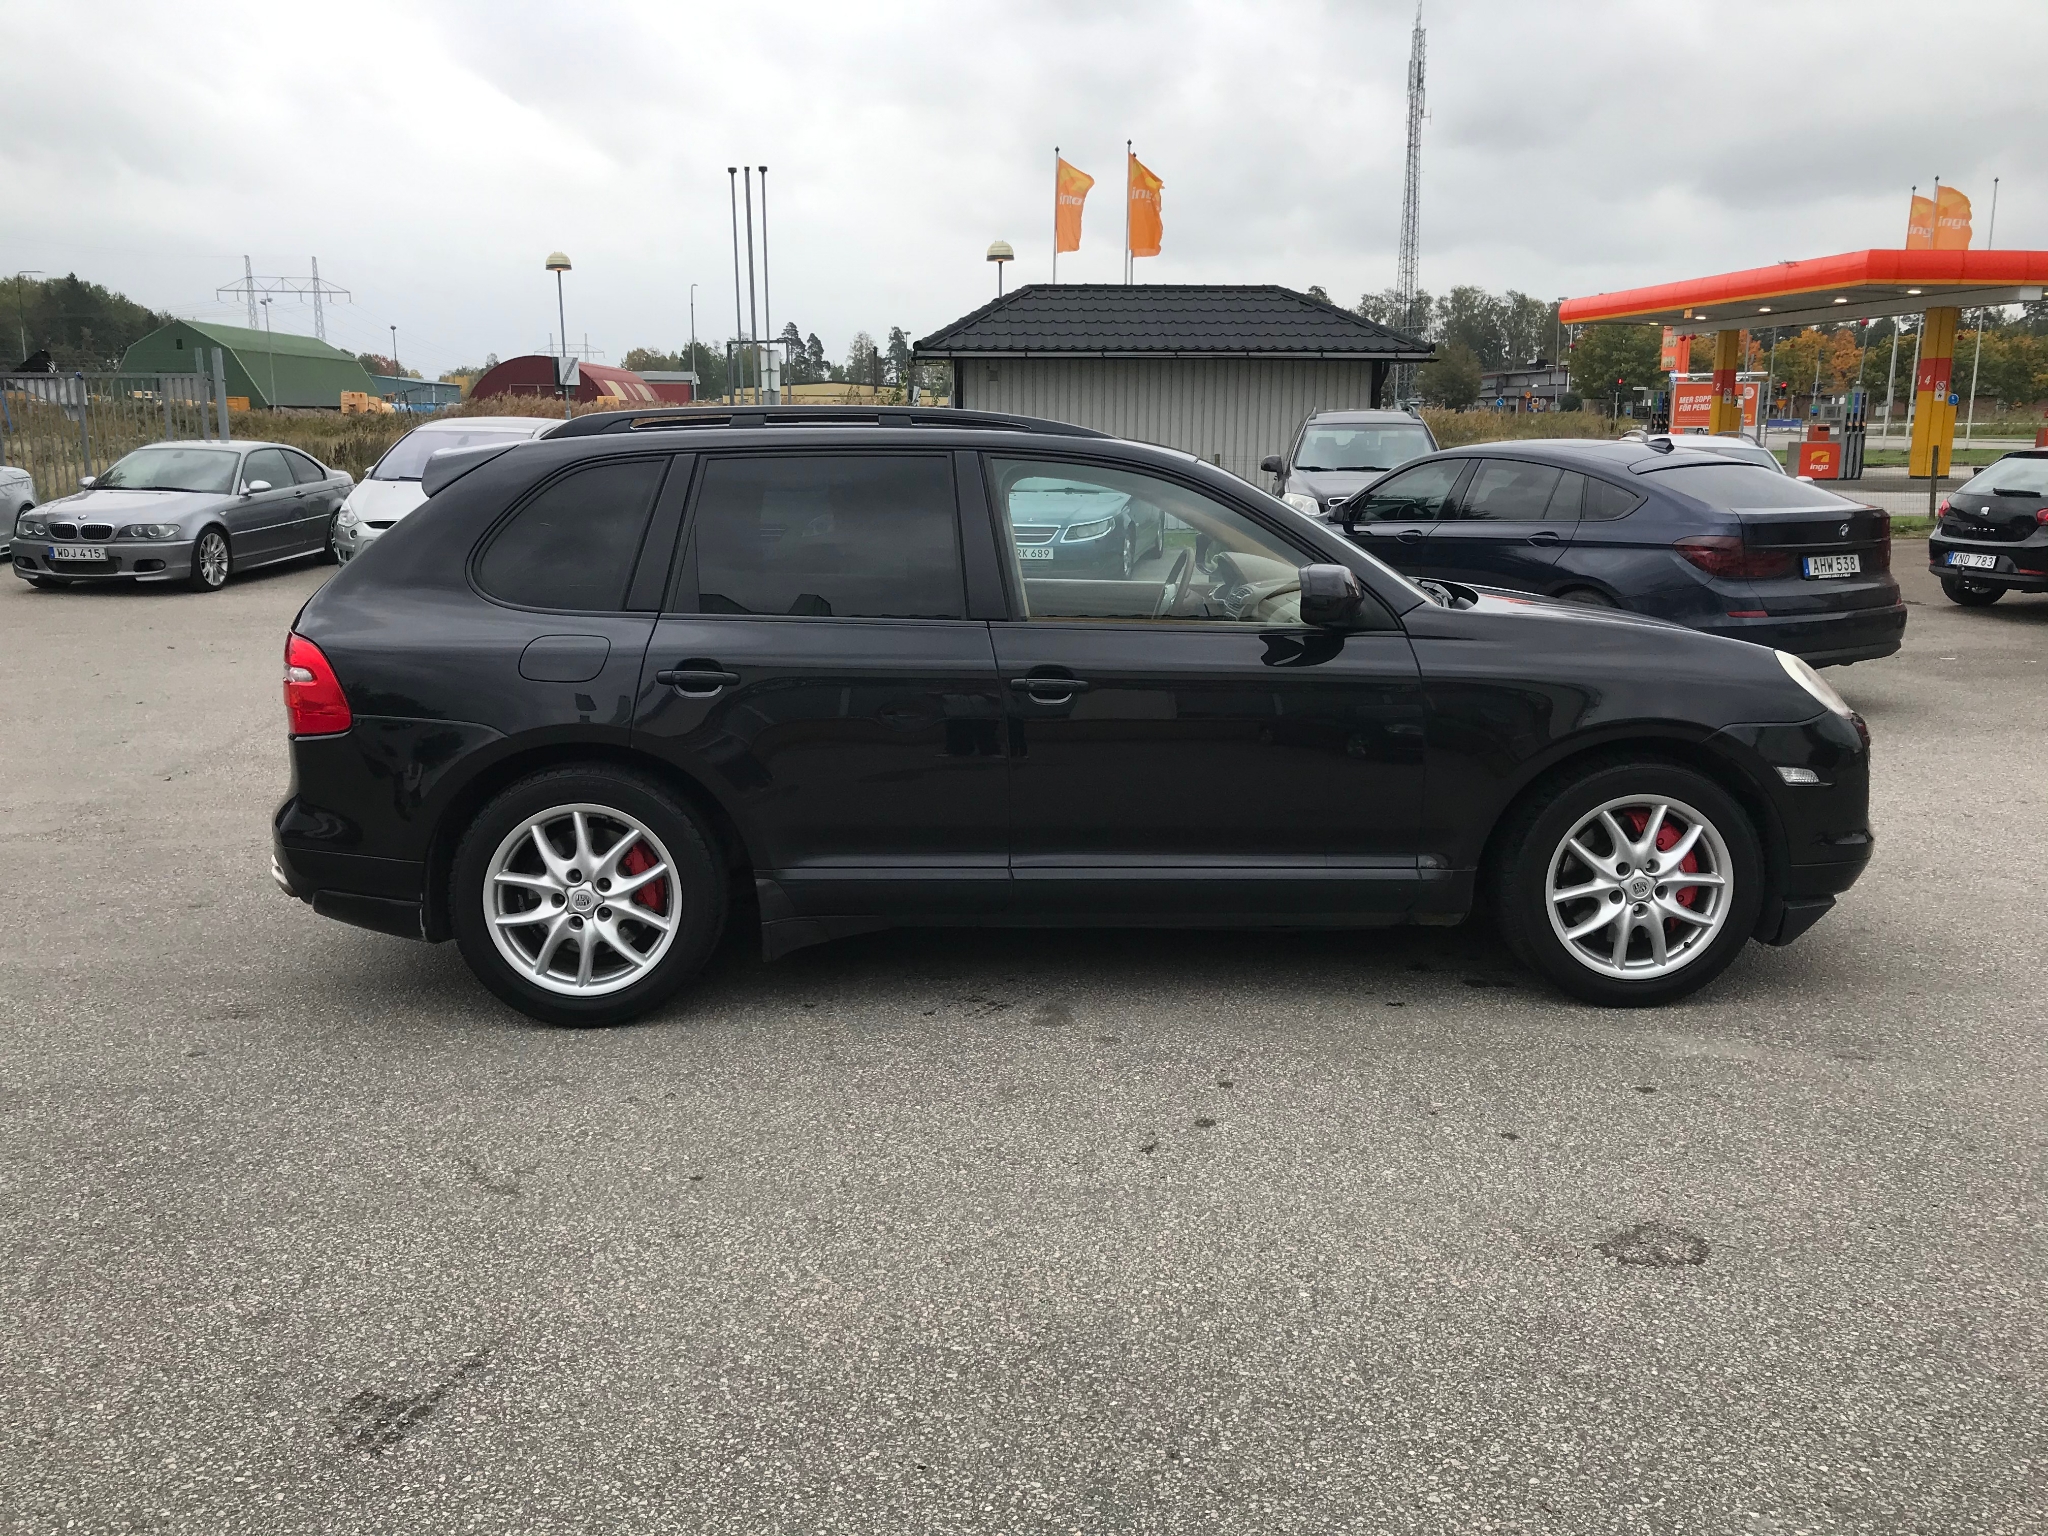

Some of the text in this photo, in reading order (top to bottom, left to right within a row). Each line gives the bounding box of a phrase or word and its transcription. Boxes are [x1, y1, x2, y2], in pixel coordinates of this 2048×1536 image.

[1909, 225, 1932, 238] ing
[1924, 375, 1931, 385] 4
[1715, 383, 1720, 391] 2
[1679, 395, 1711, 404] MER SOPP
[1679, 404, 1692, 412] FÖR
[1810, 463, 1829, 471] ingo
[57, 549, 76, 558] WDJ
[80, 549, 101, 559] 415
[1017, 549, 1050, 558] RK 689
[1813, 556, 1856, 573] AHW 538
[1975, 556, 1993, 567] 783
